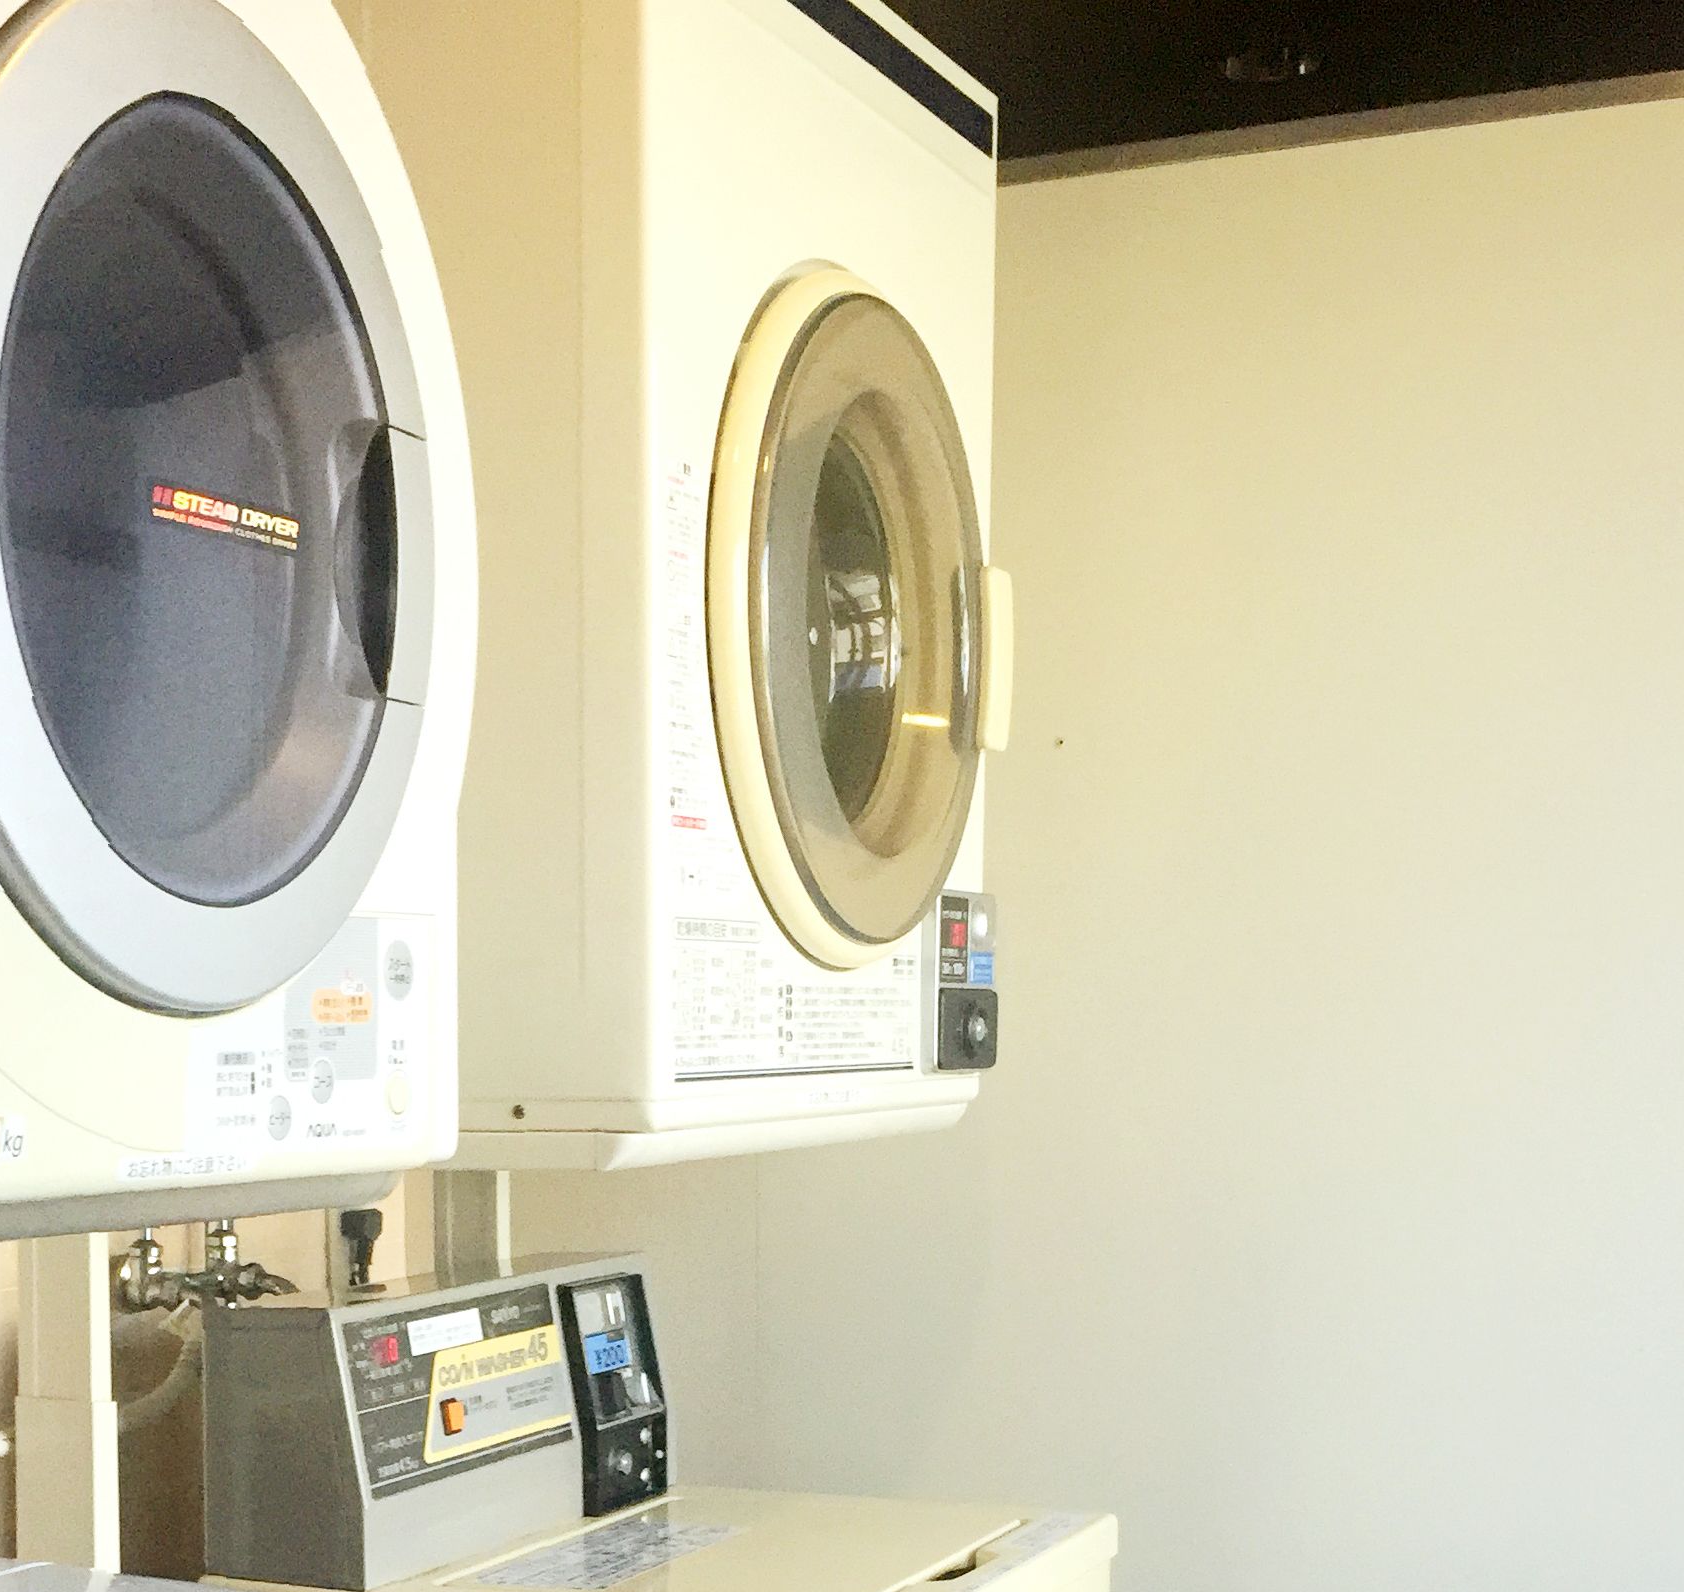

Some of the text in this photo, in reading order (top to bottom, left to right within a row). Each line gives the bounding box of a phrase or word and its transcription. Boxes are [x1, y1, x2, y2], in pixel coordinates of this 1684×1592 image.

[173, 489, 240, 523] STEAM
[240, 507, 300, 539] DRYER
[305, 1123, 337, 1139] AQUA
[528, 1332, 549, 1363] 45
